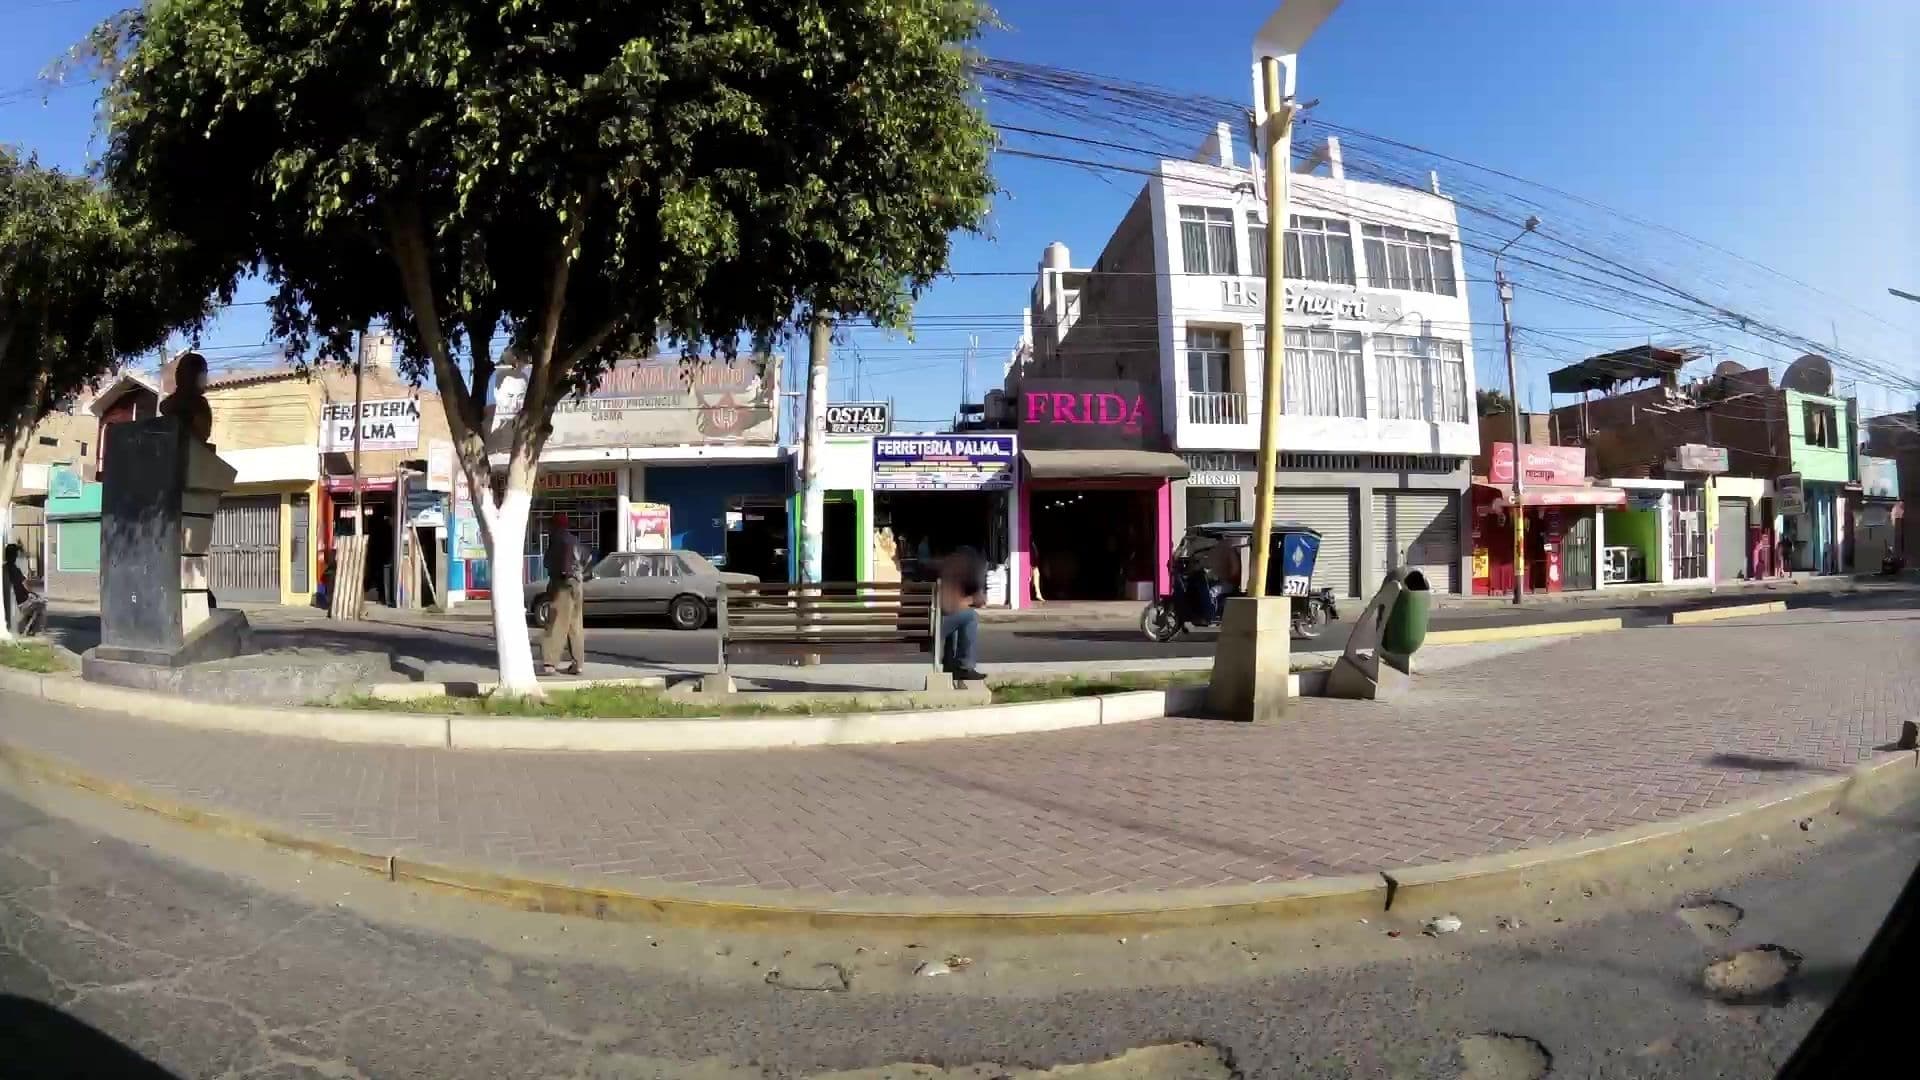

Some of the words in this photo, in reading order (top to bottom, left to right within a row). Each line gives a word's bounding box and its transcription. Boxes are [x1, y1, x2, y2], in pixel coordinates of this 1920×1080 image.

[827, 407, 885, 423] OSTAL
[1024, 392, 1147, 425] FRIDA
[877, 440, 952, 456] FERRETERIA
[956, 440, 1001, 456] PALMA
